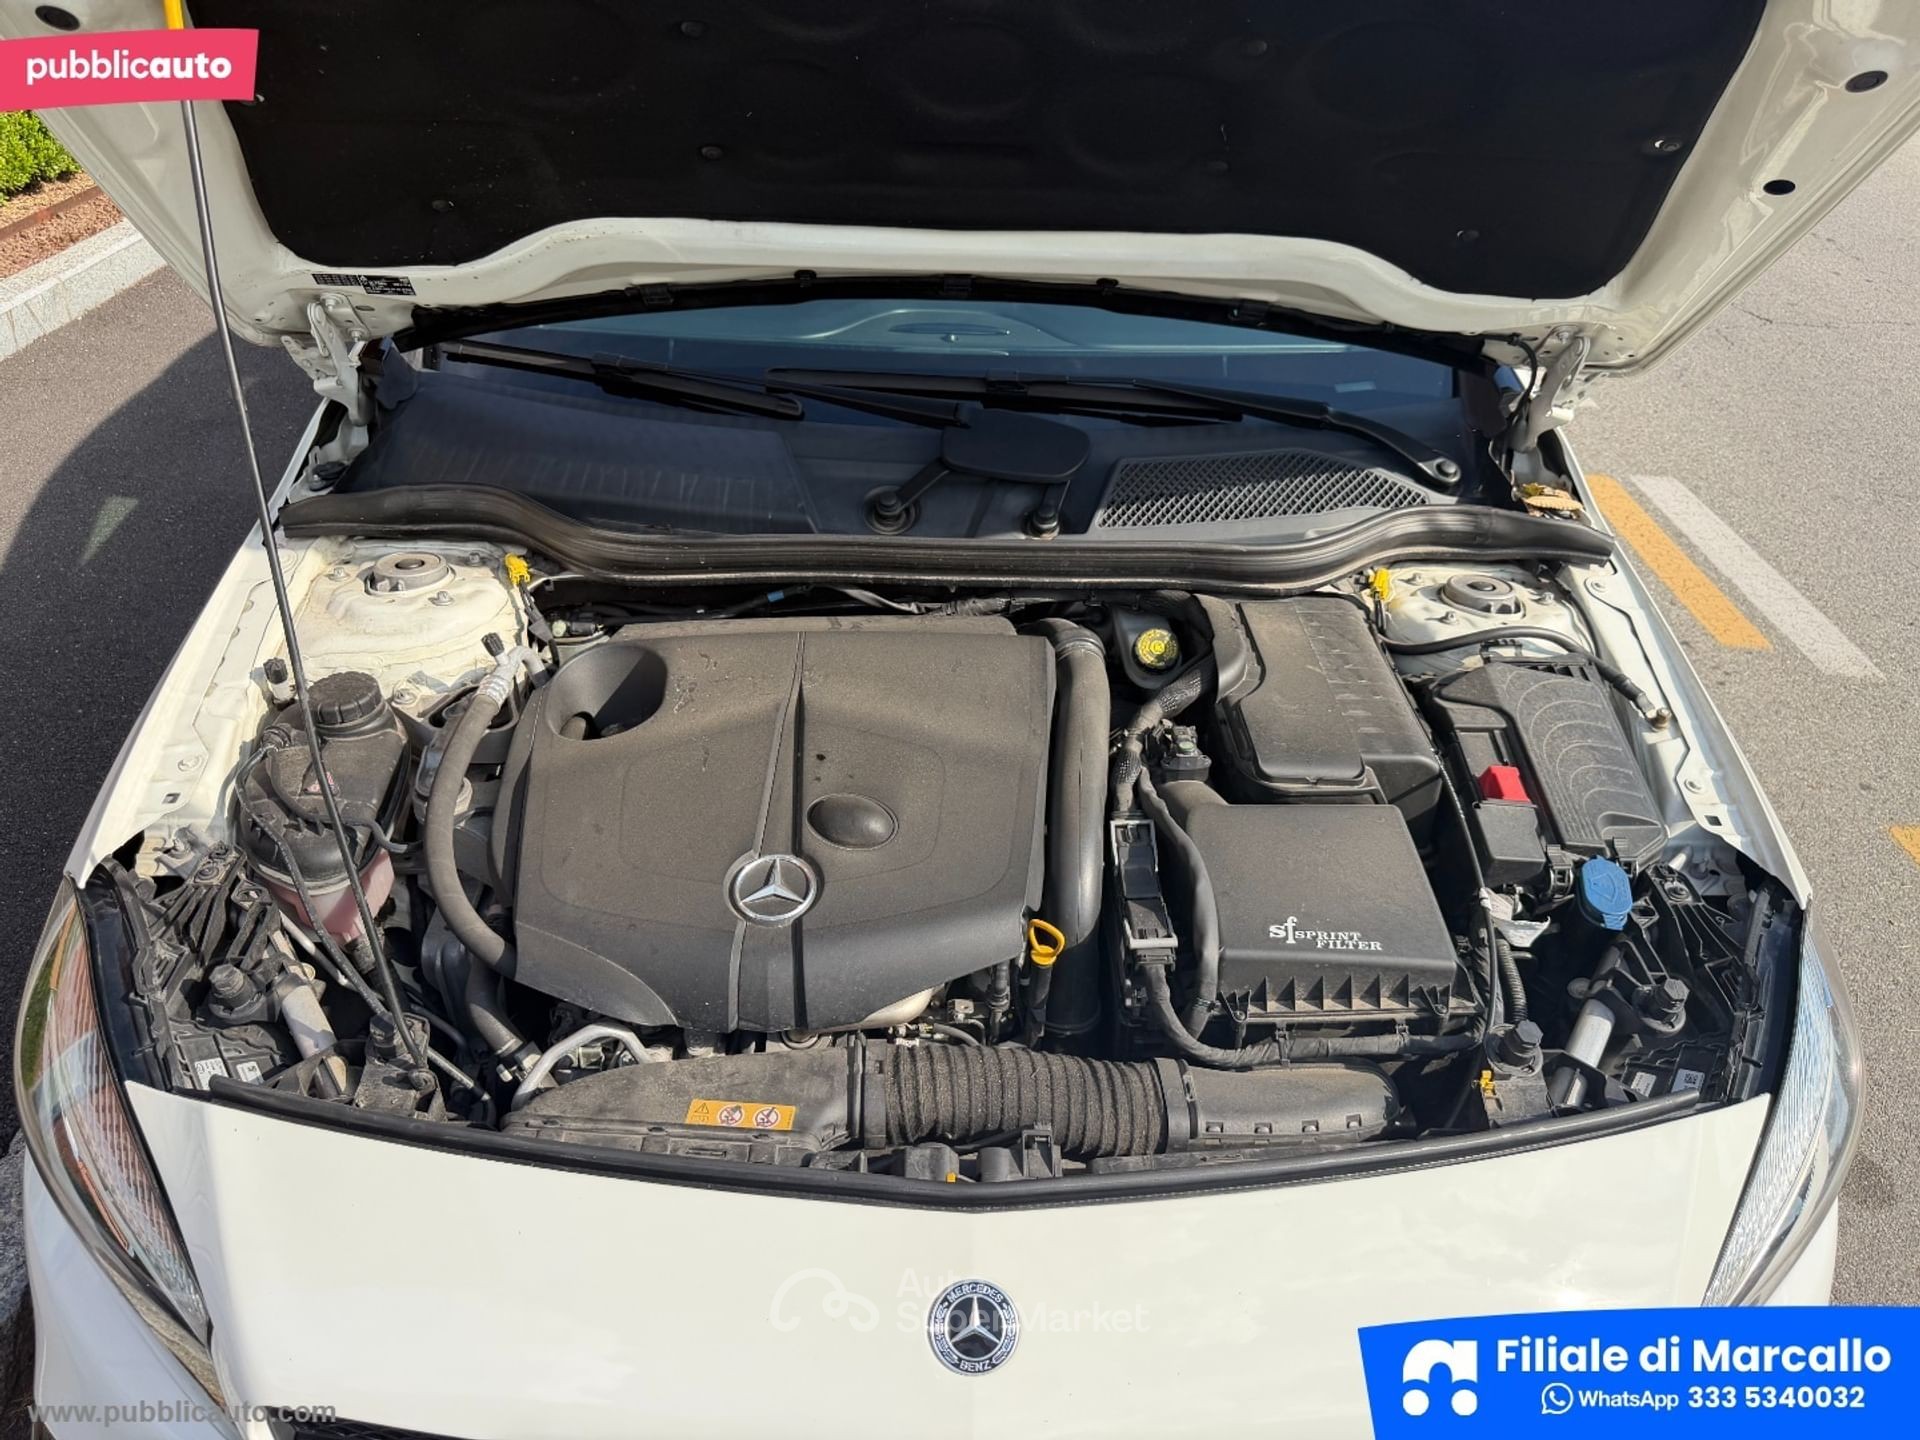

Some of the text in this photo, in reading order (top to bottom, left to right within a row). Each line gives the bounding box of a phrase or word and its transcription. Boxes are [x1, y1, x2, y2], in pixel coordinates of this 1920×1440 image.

[1295, 930, 1361, 941] SPRINT
[1316, 939, 1383, 951] FILTER
[946, 1282, 1005, 1303] MERCEDES
[959, 1359, 993, 1372] BENZ
